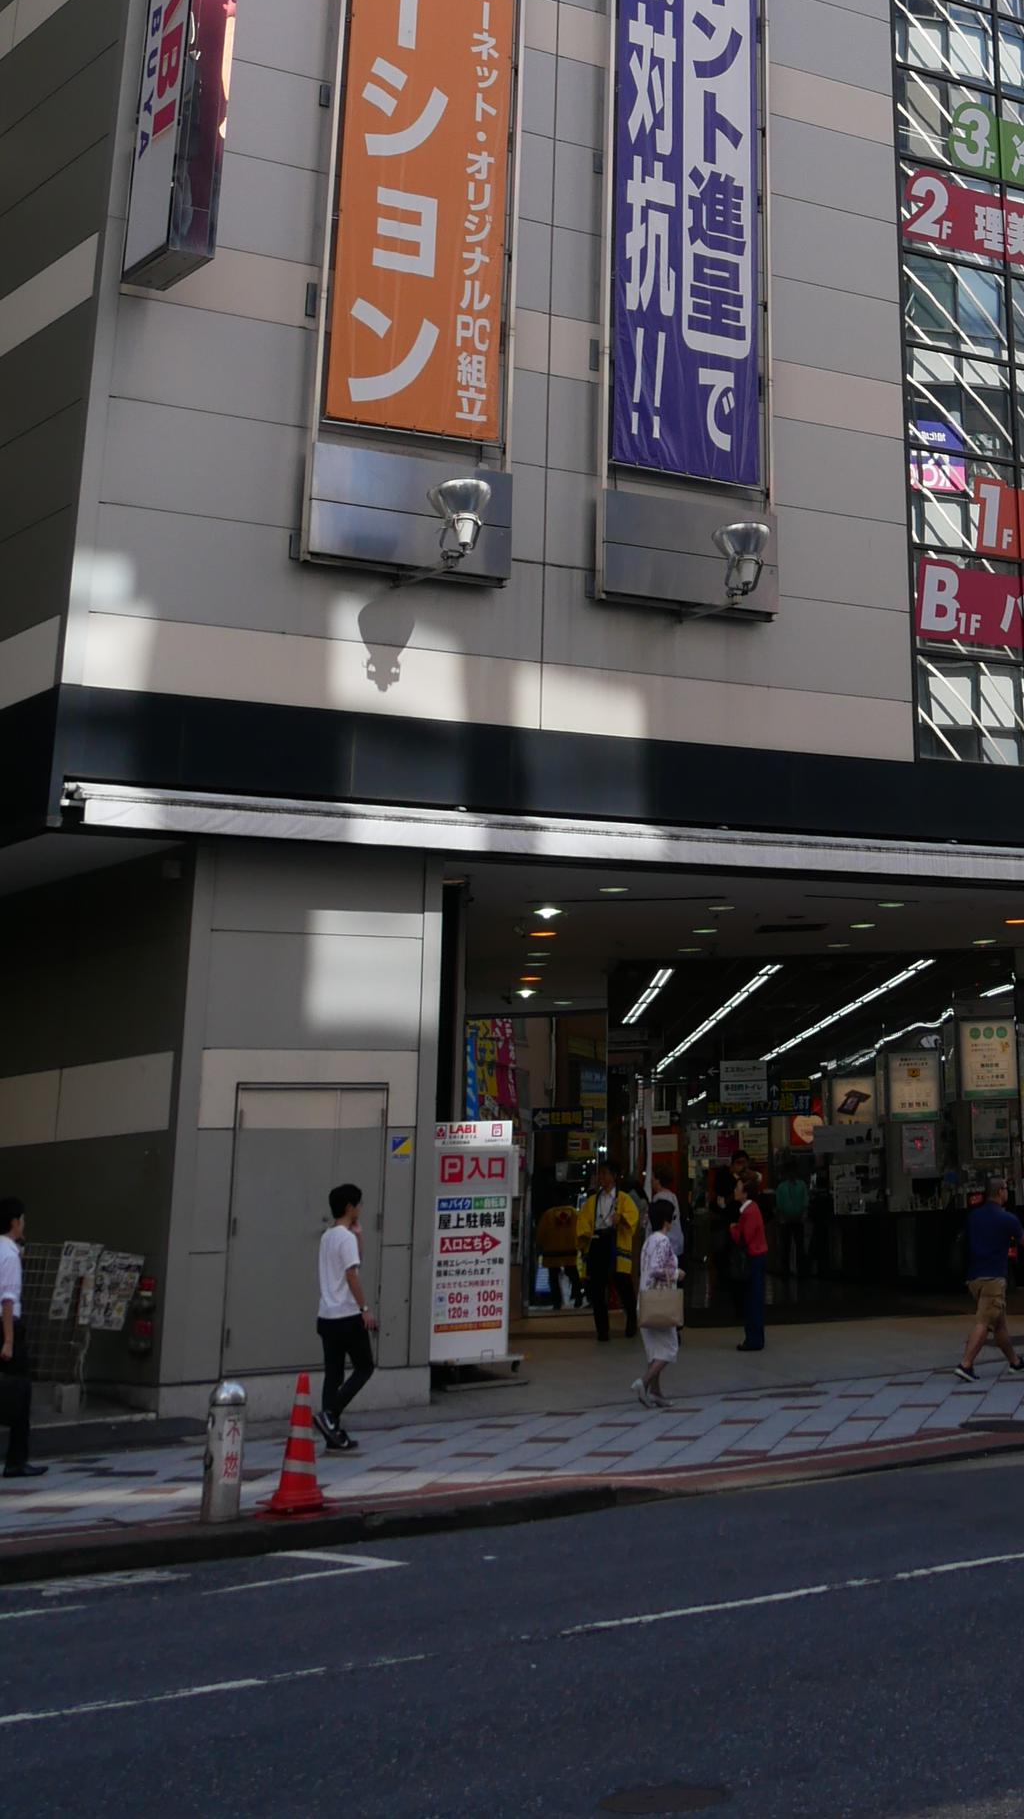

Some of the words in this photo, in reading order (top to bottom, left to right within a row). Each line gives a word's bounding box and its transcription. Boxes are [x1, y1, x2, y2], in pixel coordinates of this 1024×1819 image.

[953, 107, 996, 170] 3F
[907, 176, 952, 240] 2F
[978, 484, 1013, 550] 1F
[449, 1125, 476, 1134] LABI
[467, 1157, 505, 1179] 入口
[438, 1212, 504, 1229] 屋上駐輪場
[442, 1237, 493, 1251] 入口こちら
[448, 1292, 469, 1304] 60分
[477, 1290, 503, 1302] 100円
[448, 1308, 469, 1319] 120分
[477, 1305, 503, 1317] 100円
